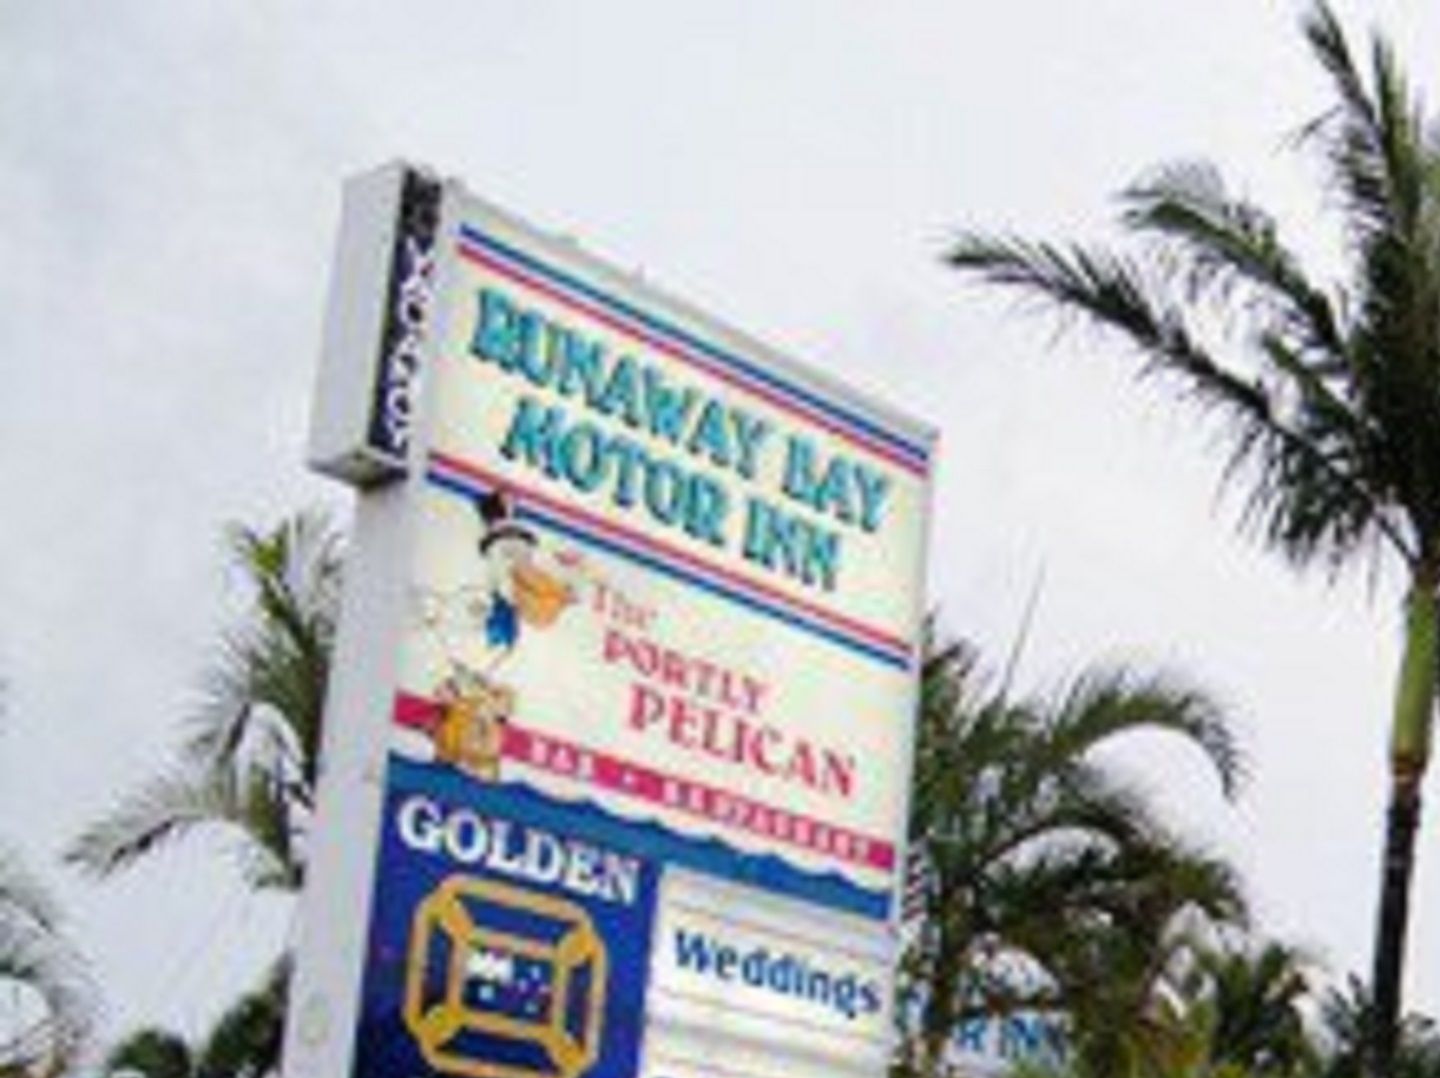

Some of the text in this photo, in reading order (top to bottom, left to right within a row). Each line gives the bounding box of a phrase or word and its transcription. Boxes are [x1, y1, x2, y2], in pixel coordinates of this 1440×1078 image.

[470, 288, 772, 480] RUNAWAY
[500, 396, 842, 590] MOTOR INN
[602, 628, 774, 715] PORTLY
[626, 682, 859, 798] PELICAN
[396, 796, 642, 904] GOLDEN
[671, 926, 884, 1022] Weddings
